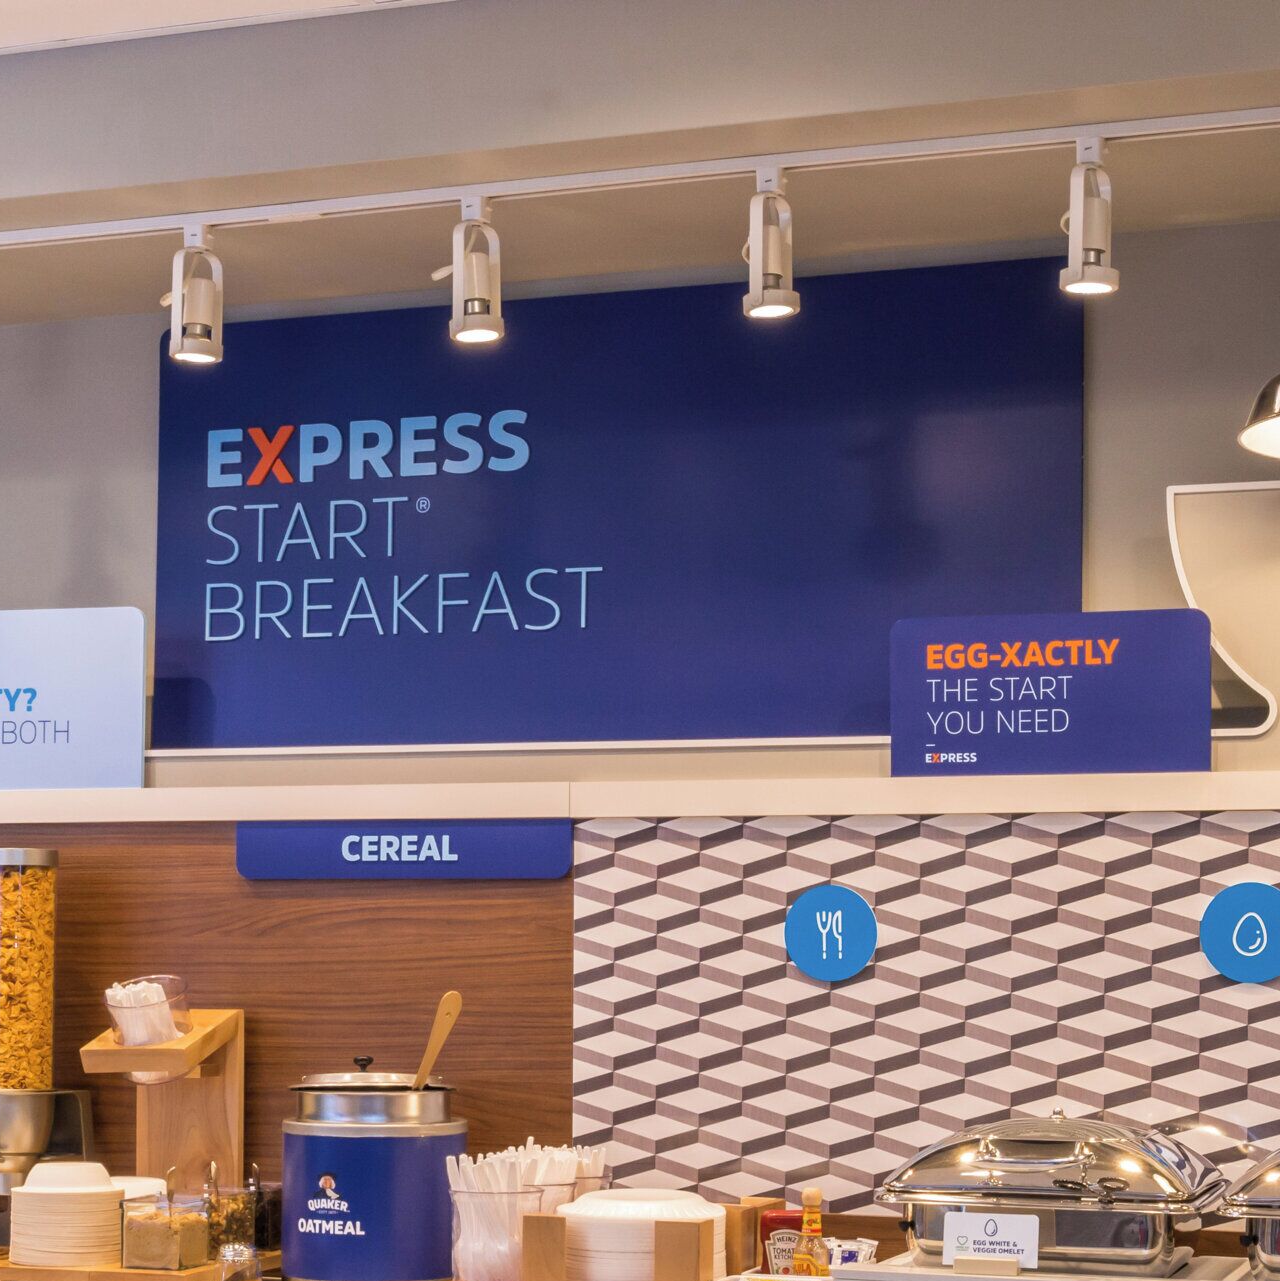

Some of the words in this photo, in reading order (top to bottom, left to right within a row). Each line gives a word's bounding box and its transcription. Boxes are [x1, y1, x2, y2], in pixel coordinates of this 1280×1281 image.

[207, 409, 530, 488] EXPRESS
[204, 566, 604, 641] BREAKFAST
[926, 638, 1120, 670] EGG-XACTLY
[926, 678, 979, 703] THE
[989, 675, 1073, 702] START
[1, 719, 71, 745] BOTH
[926, 710, 985, 735] YOU
[997, 708, 1070, 734] NEED
[925, 752, 977, 764] EXPRESS
[341, 834, 459, 862] CEREAL
[307, 1199, 349, 1212] QUAKER
[298, 1218, 365, 1235] OATMEAL
[998, 1247, 1024, 1255] OMELET
